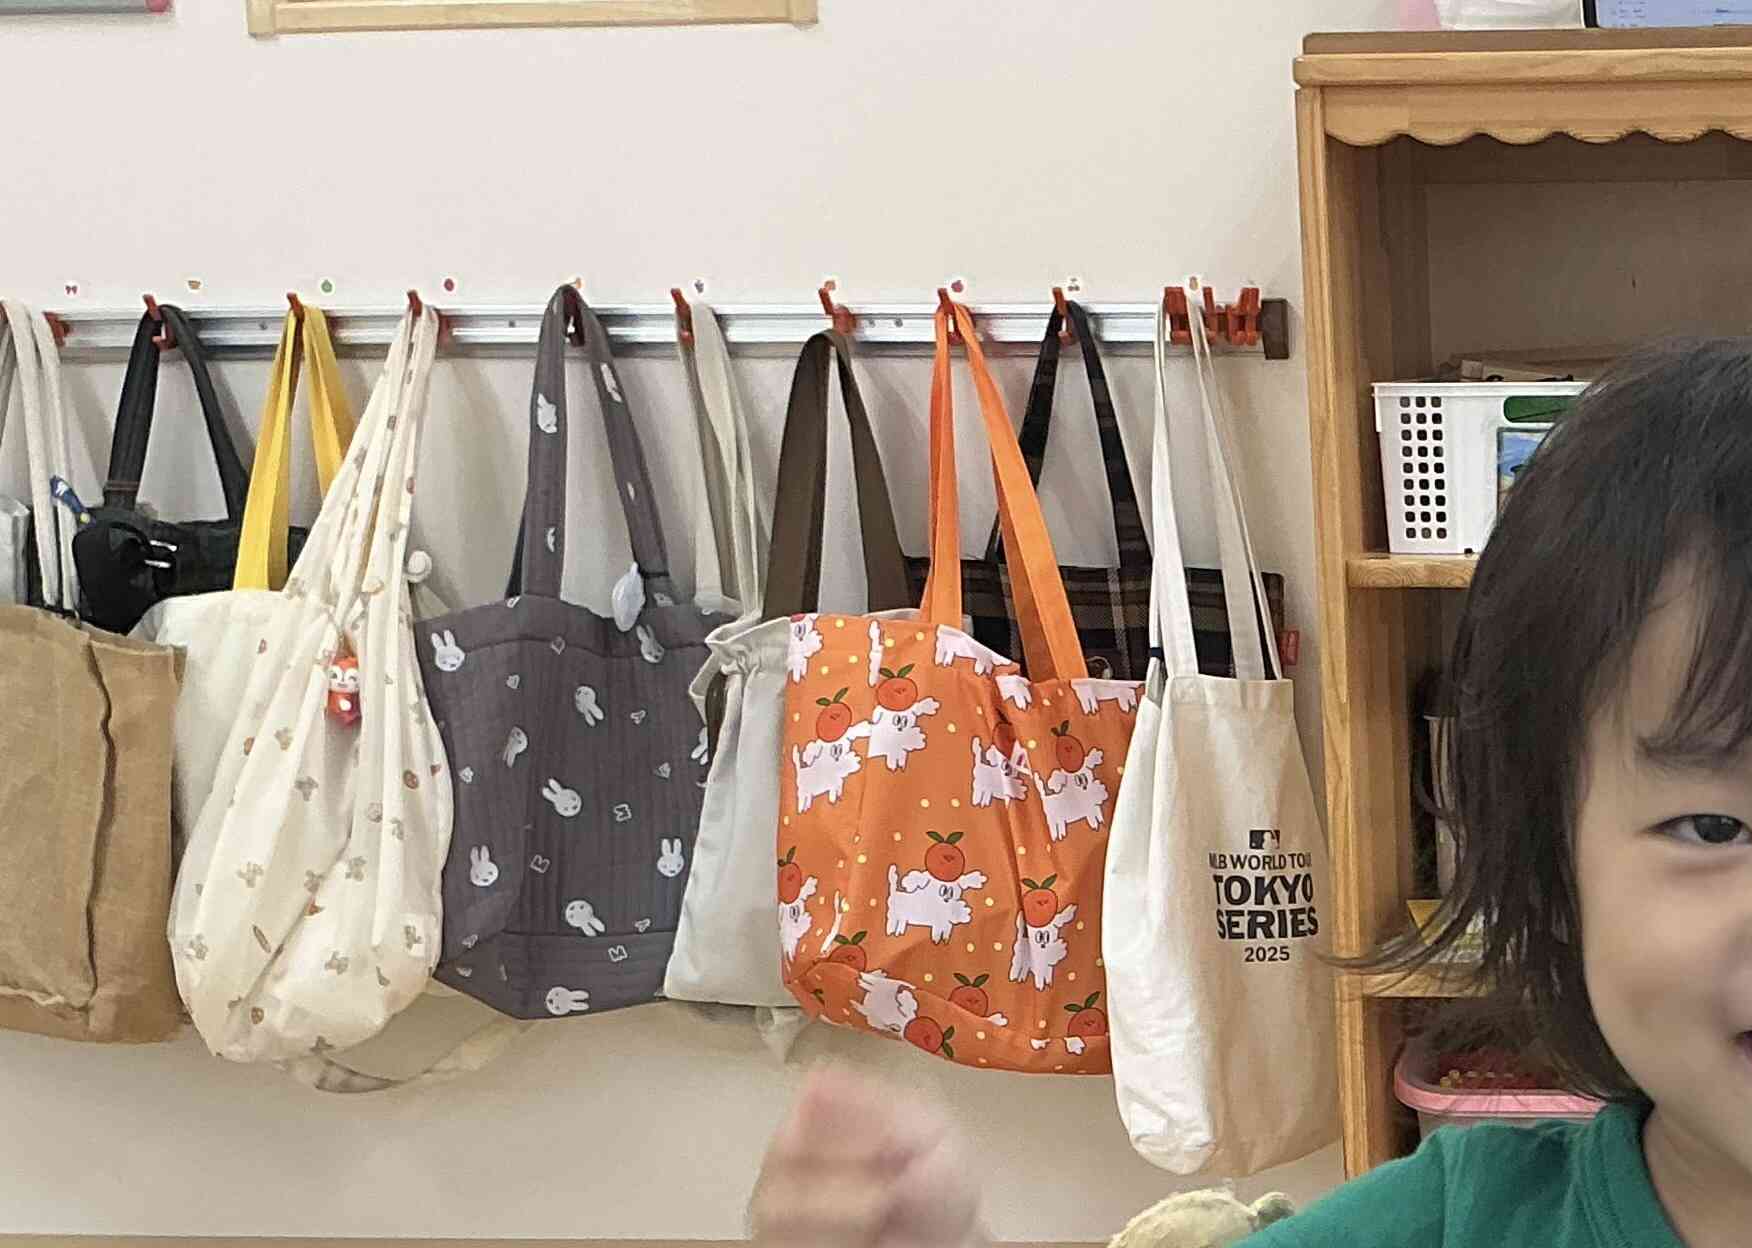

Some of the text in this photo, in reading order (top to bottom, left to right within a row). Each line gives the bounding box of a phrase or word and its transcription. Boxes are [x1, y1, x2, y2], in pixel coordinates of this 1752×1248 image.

[1230, 853, 1286, 870] WORLD
[1213, 873, 1313, 905] TOKYO
[1216, 906, 1319, 939] SERIES
[1244, 946, 1290, 962] 2025
